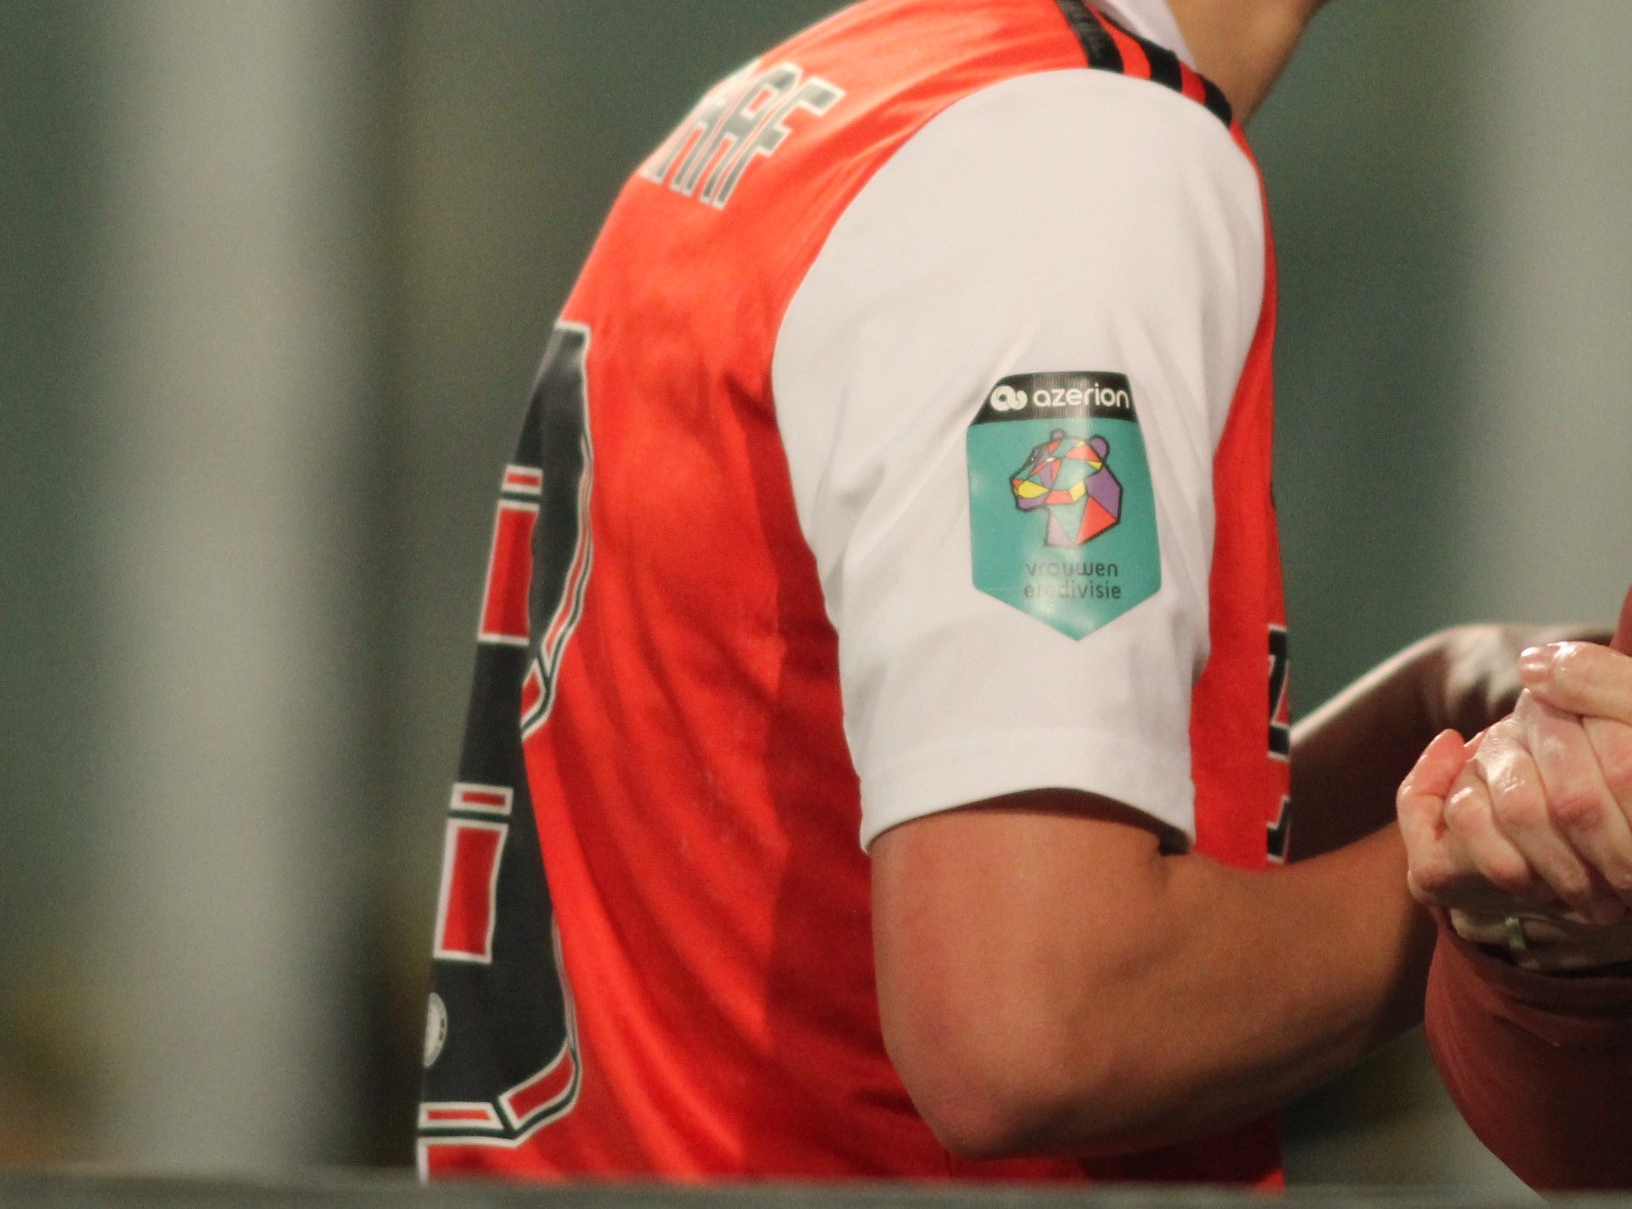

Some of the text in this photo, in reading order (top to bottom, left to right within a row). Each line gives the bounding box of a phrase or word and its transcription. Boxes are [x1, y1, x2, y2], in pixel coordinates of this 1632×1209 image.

[638, 60, 848, 211] AAF
[1032, 383, 1131, 409] azerion
[1025, 561, 1119, 578] vrouwen
[1023, 579, 1122, 600] eredivisie
